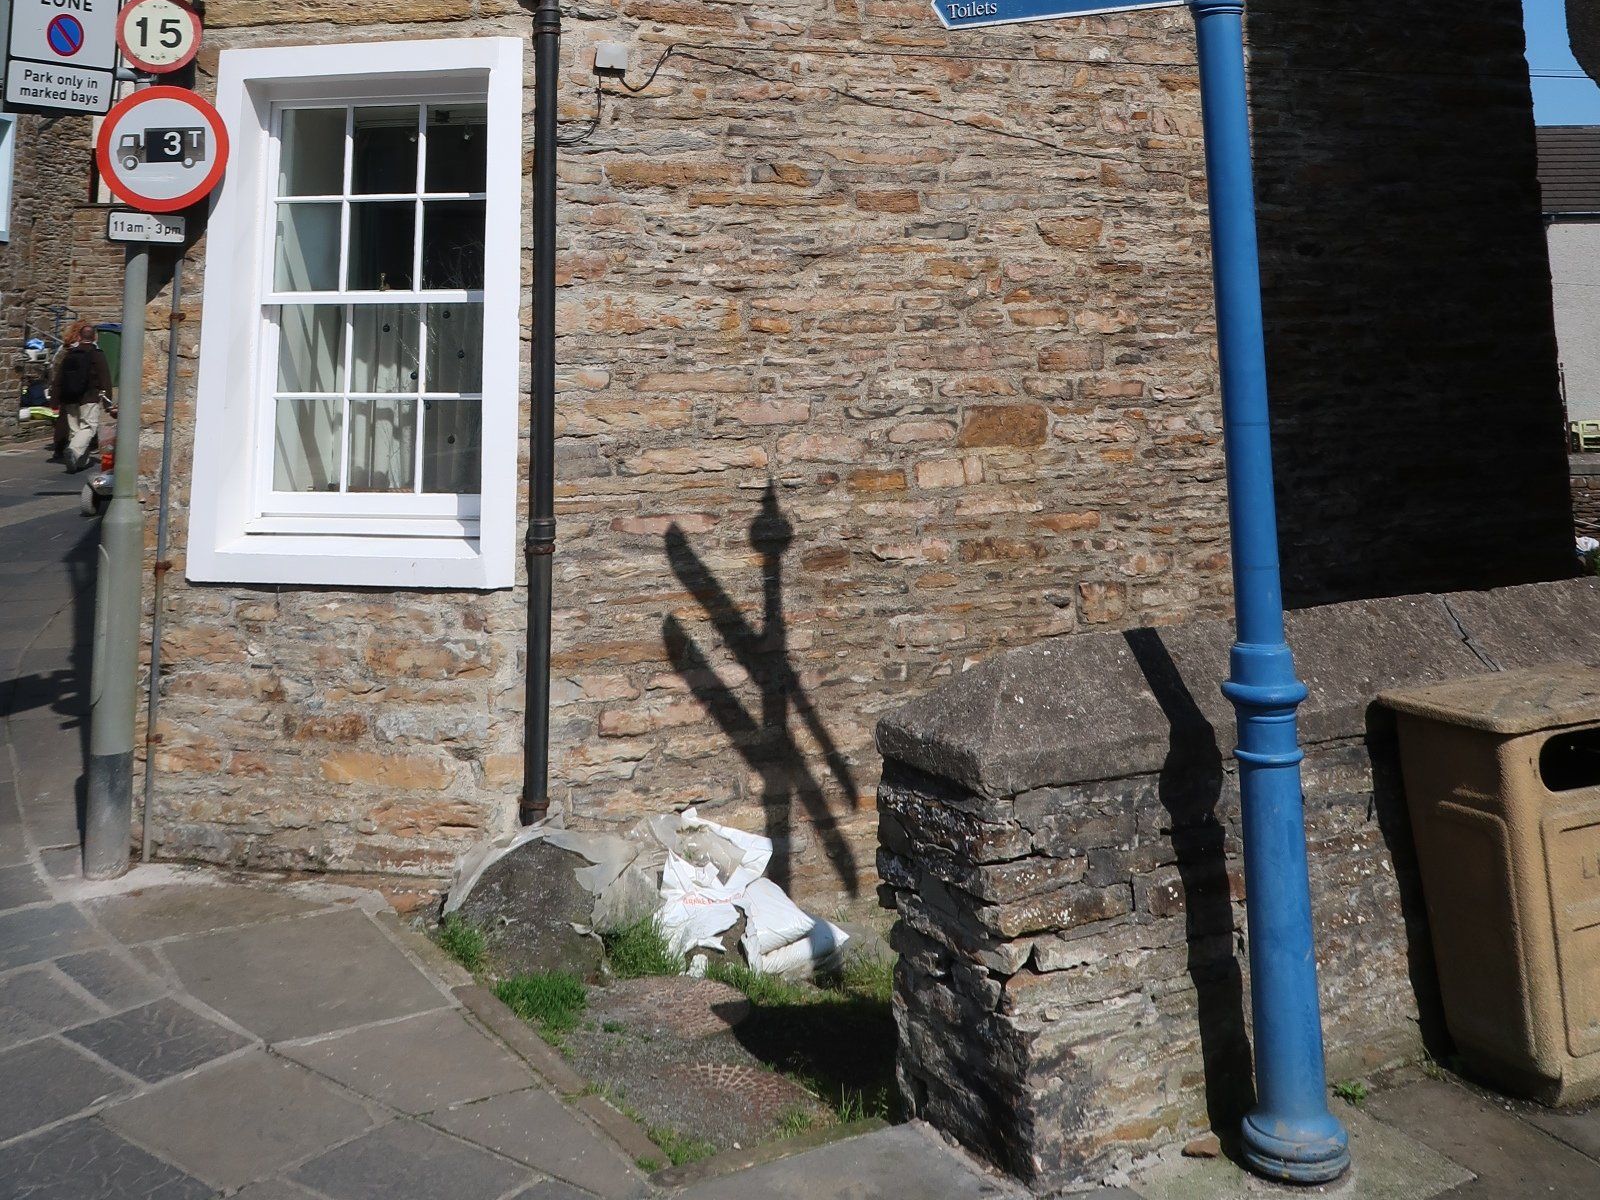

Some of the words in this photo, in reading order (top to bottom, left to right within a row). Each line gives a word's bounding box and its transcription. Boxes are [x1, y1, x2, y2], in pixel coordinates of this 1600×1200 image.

[947, 2, 998, 19] Toilets
[136, 17, 182, 48] 15
[24, 69, 53, 83] Park
[57, 75, 83, 89] only
[87, 77, 98, 89] in
[20, 87, 67, 101] marked
[71, 91, 99, 105] bays
[113, 221, 144, 233] 11am
[155, 223, 181, 236] 3pm
